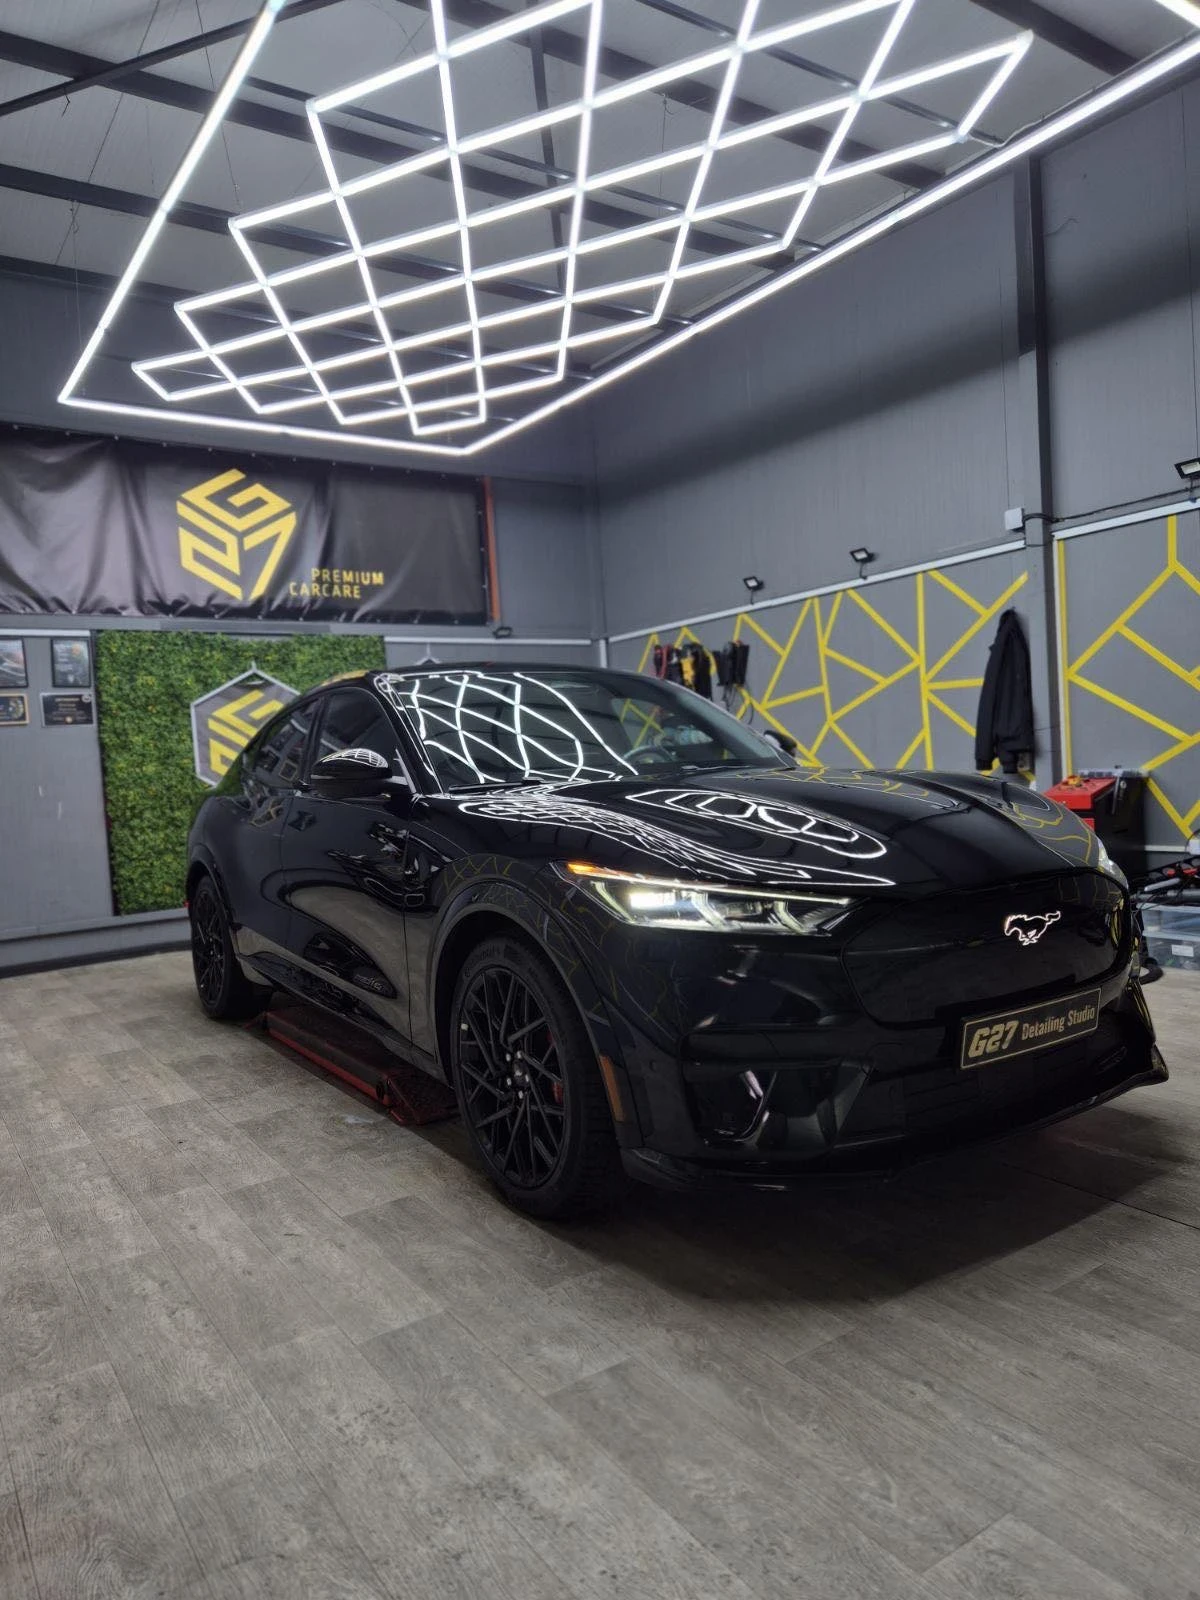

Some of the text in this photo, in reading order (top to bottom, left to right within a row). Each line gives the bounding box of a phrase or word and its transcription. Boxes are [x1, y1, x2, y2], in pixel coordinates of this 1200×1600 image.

[311, 568, 384, 585] PREMIUM
[289, 582, 361, 599] CARCARE
[968, 1005, 1096, 1058] G27 Detailing Studio
